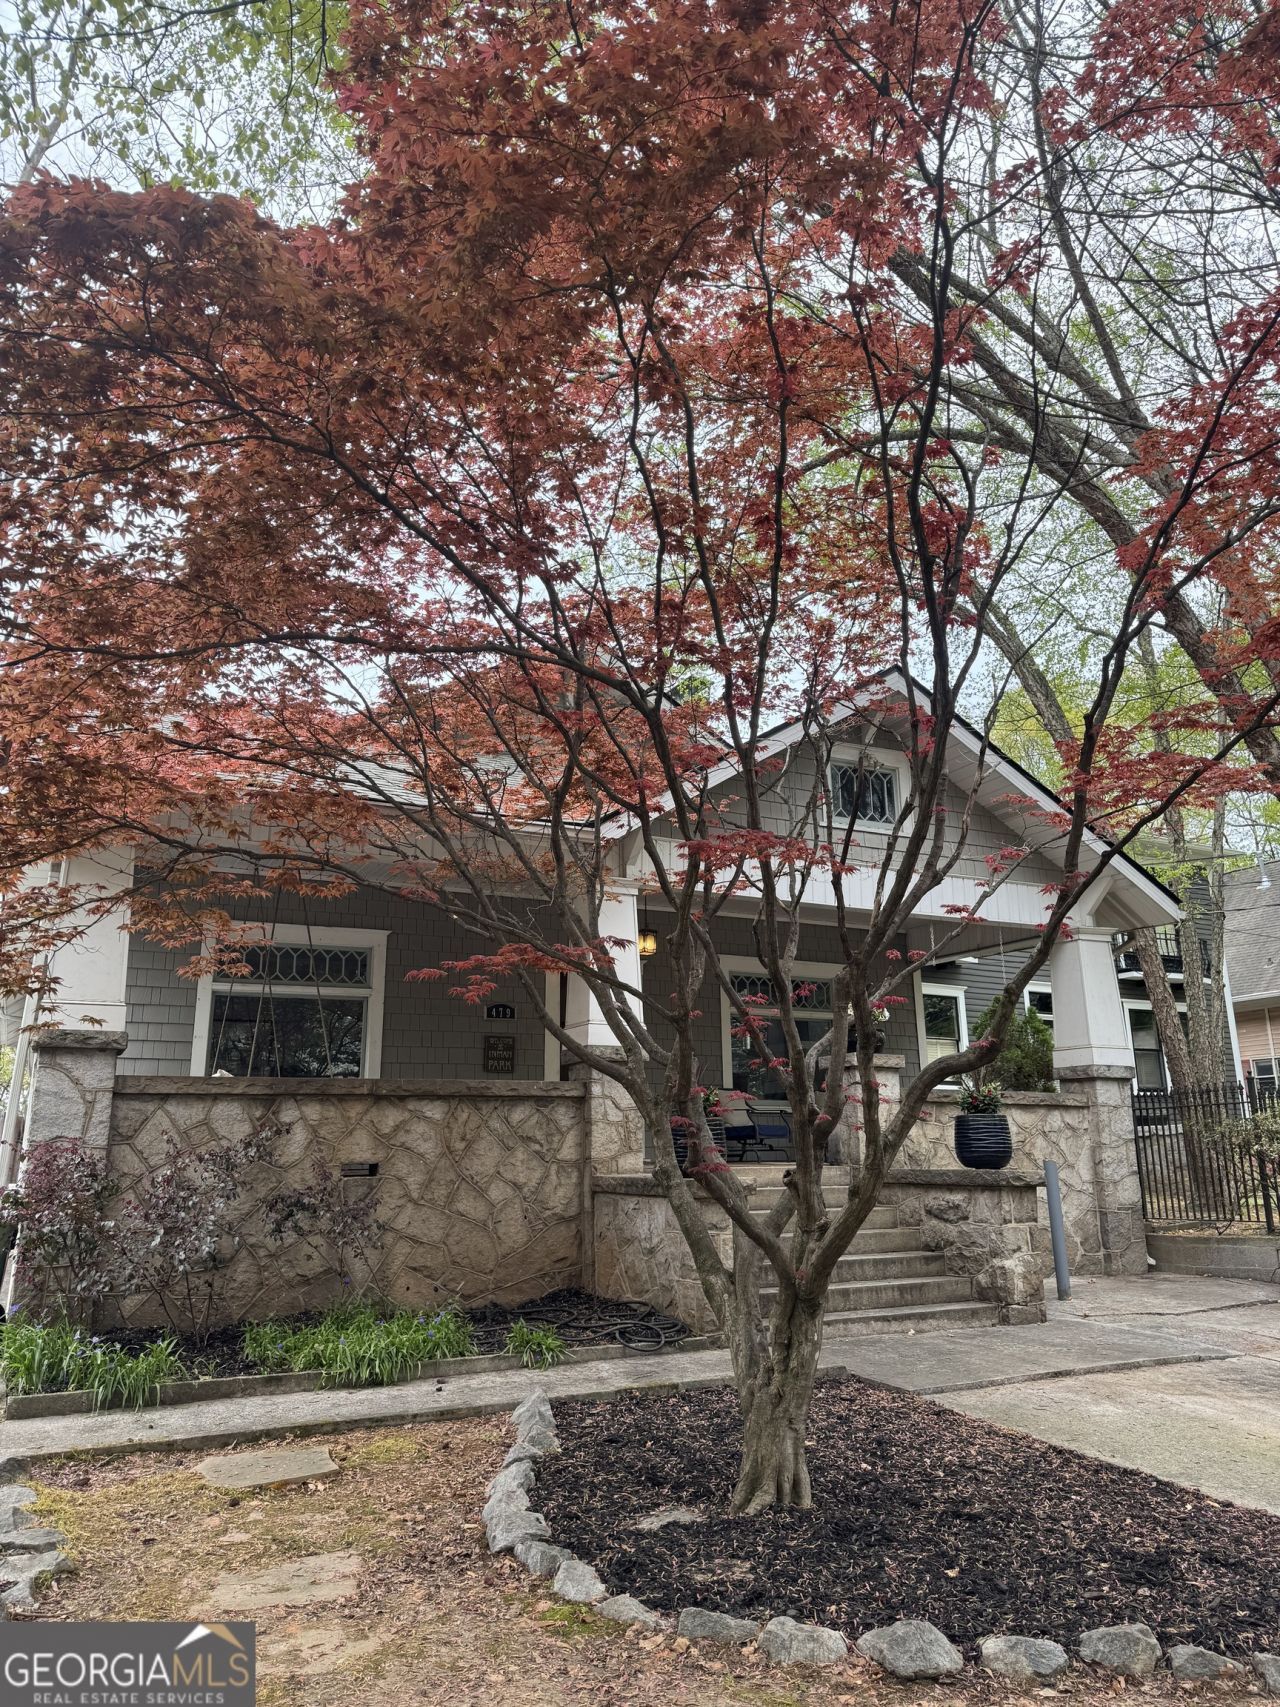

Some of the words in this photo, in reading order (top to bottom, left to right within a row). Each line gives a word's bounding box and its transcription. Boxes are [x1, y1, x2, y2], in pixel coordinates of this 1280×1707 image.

[491, 1007, 511, 1018] 479
[488, 1050, 513, 1059] INMAN
[488, 1060, 512, 1071] PARK
